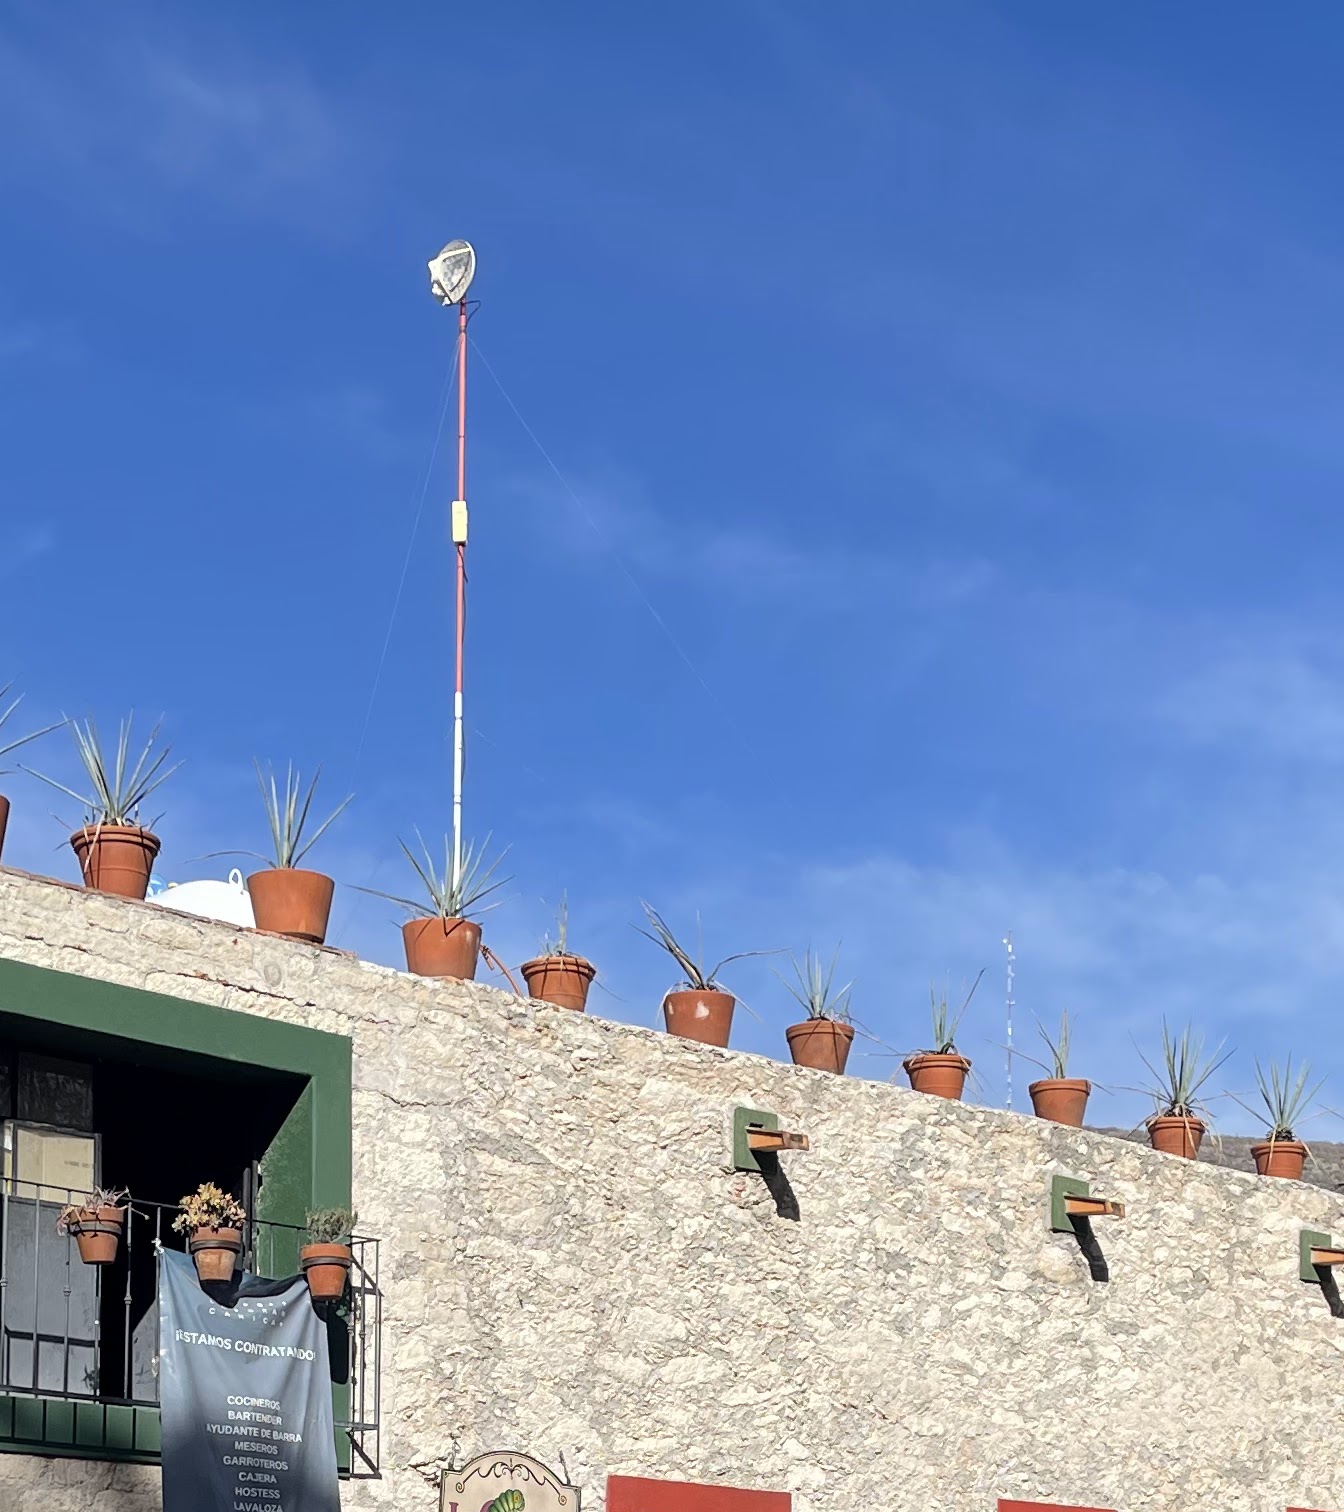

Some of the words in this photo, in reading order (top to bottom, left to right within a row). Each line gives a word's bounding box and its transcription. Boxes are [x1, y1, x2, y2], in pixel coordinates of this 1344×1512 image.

[176, 1329, 232, 1350] ¡ESTAMOS
[234, 1340, 316, 1361] CONTRATANDO!
[227, 1395, 281, 1410] COCINEROS
[228, 1410, 282, 1426] BARTENDER
[206, 1423, 259, 1437] AYUDANTE
[261, 1429, 272, 1439] DE
[273, 1431, 303, 1443] BARRA
[234, 1441, 279, 1455] MESEROS
[223, 1455, 289, 1471] GARROTEROS
[238, 1471, 277, 1484] CAJERA
[235, 1486, 281, 1499] HOSTESS
